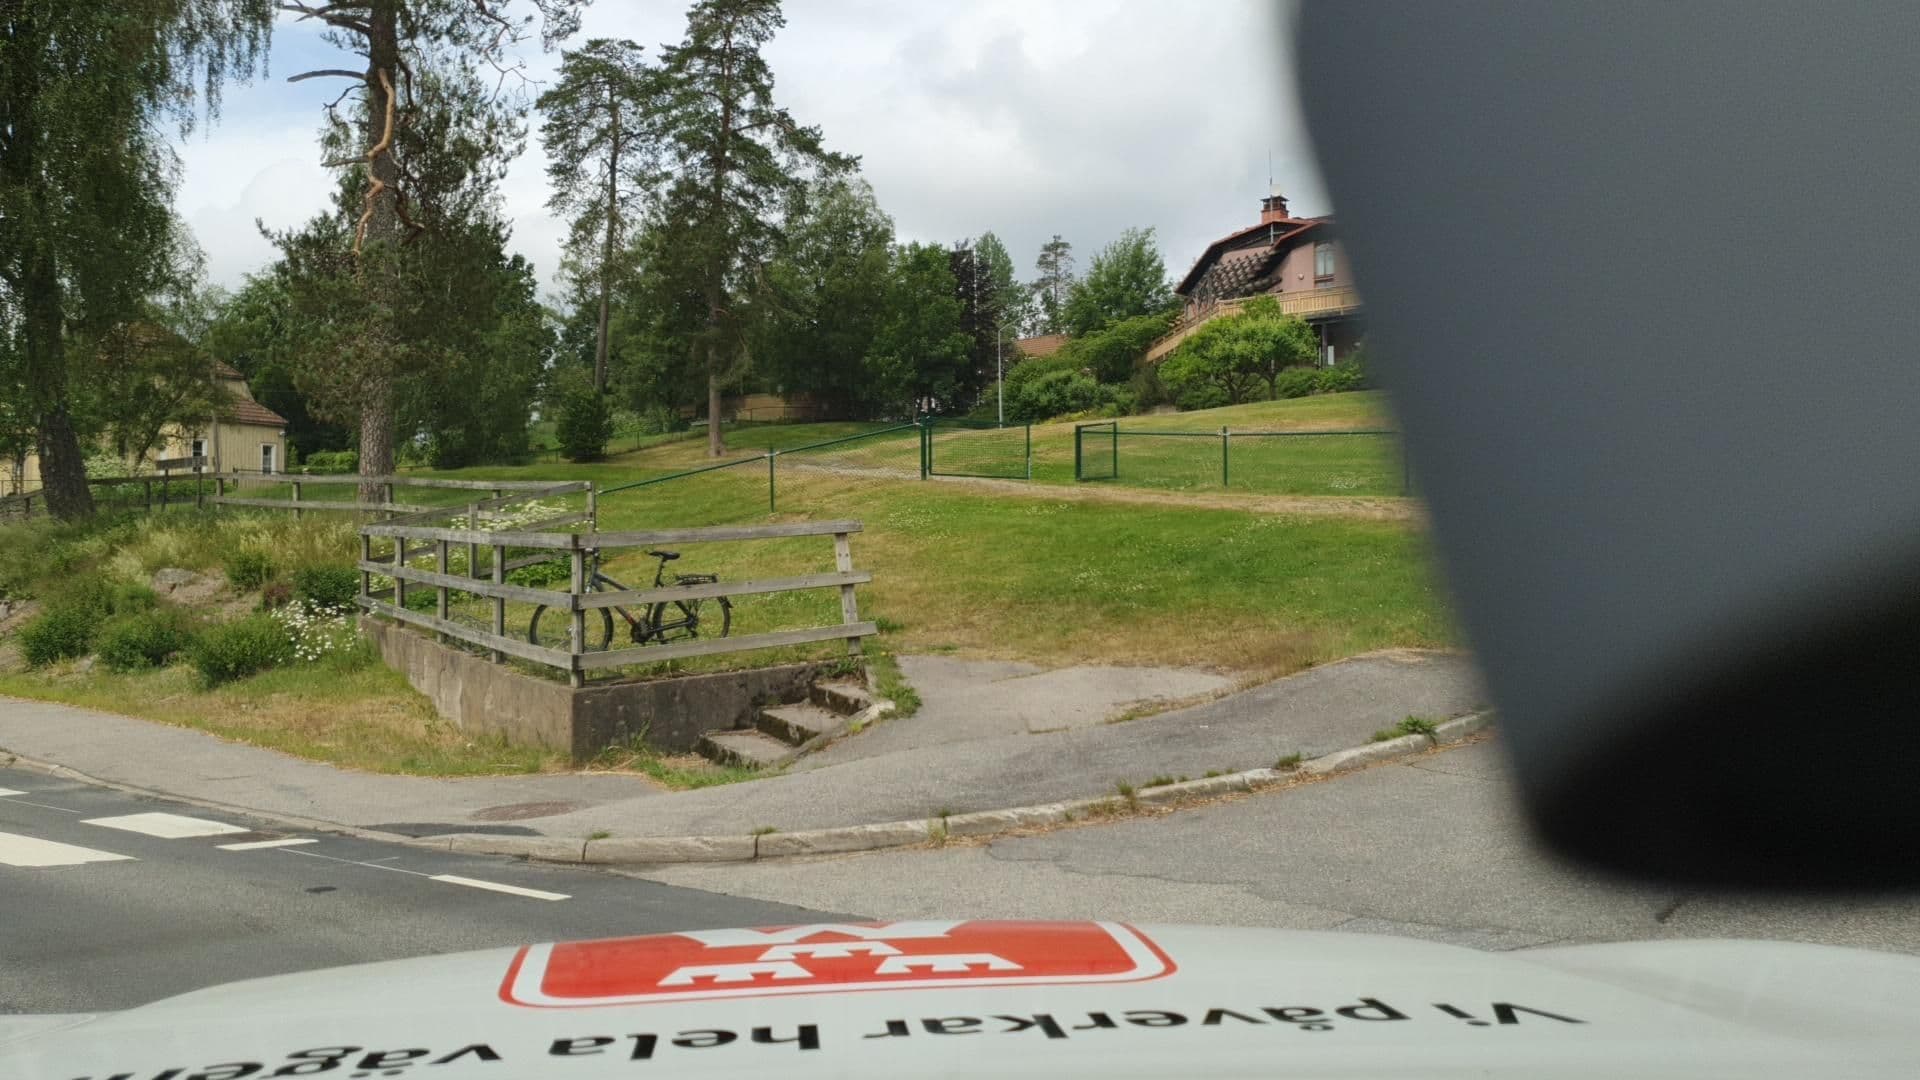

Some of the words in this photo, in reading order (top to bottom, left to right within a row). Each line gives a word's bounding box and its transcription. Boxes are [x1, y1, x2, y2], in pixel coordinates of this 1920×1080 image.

[864, 997, 1411, 1040] påverkar
[1432, 1002, 1587, 1027] Vi
[548, 1024, 820, 1061] hela
